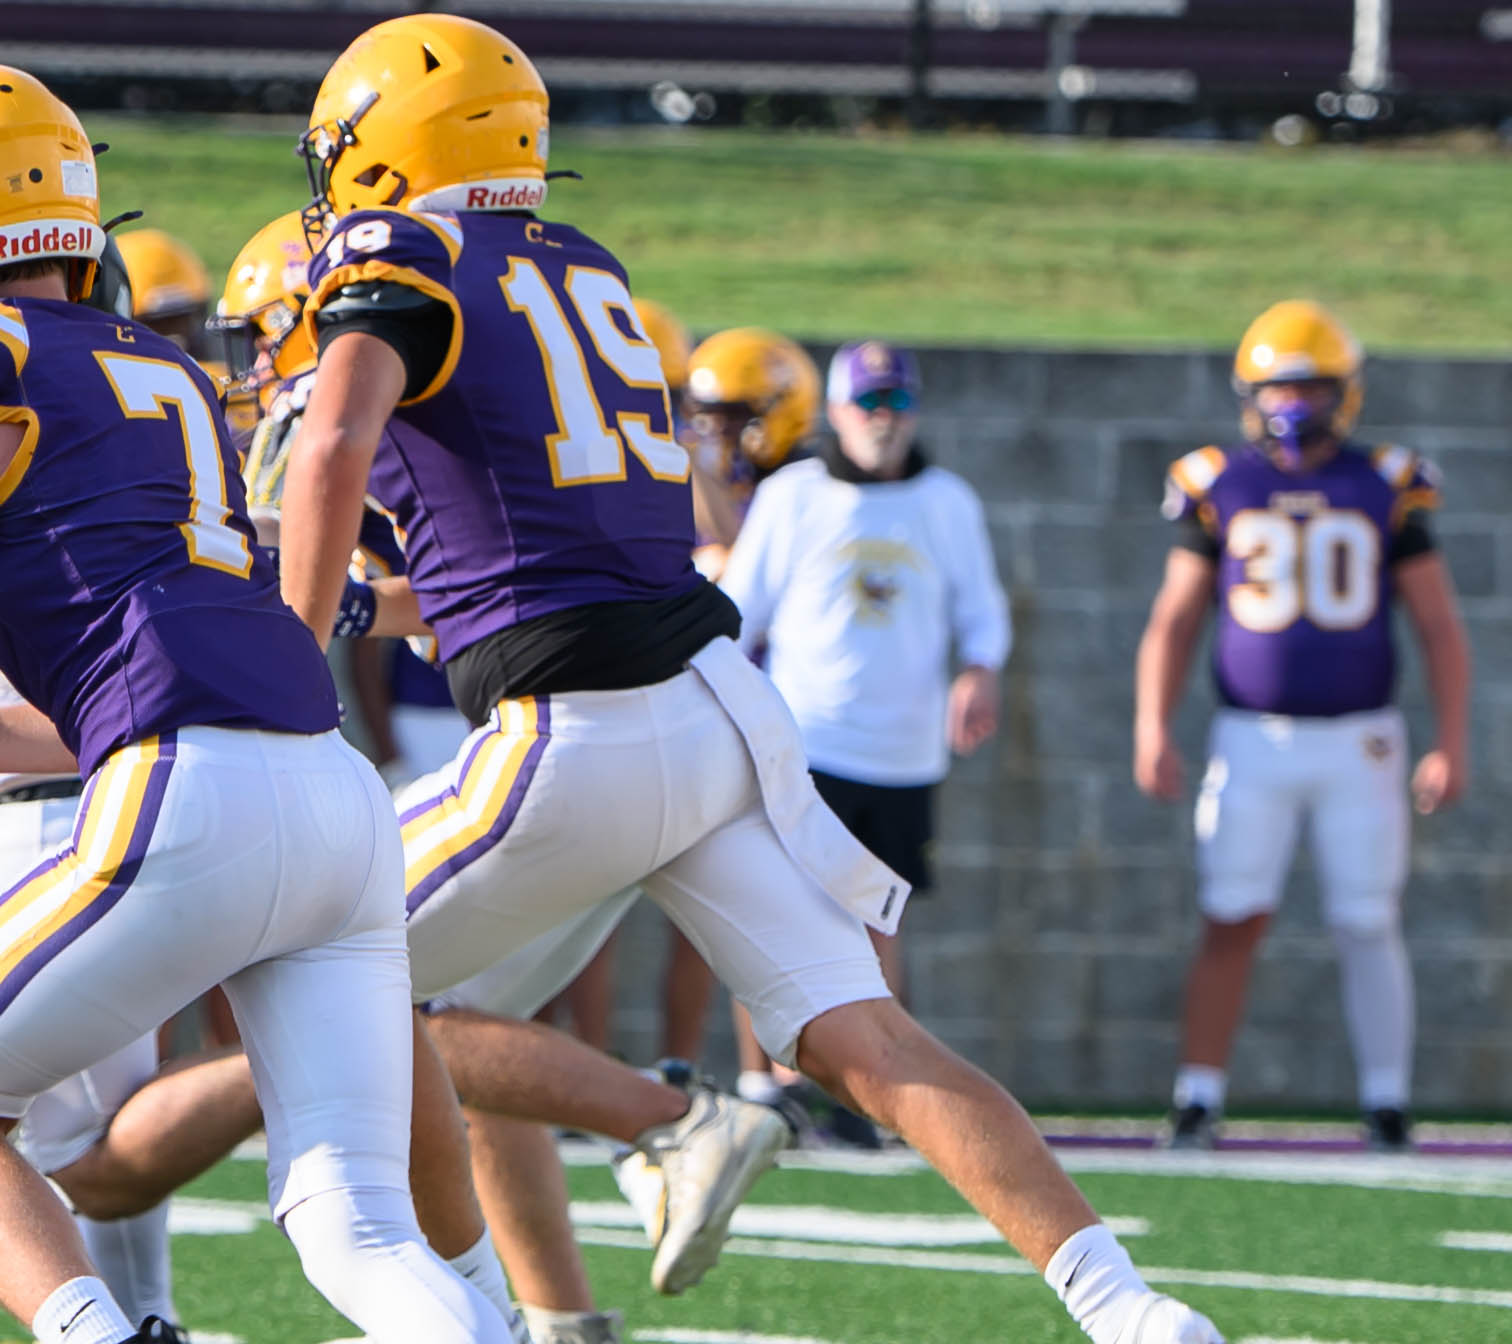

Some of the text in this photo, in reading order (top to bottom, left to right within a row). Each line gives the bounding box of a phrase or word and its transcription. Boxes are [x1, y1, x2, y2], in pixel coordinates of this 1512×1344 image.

[326, 219, 392, 269] 19
[466, 186, 544, 208] Riddel
[498, 256, 691, 489] 19
[91, 350, 254, 581] 7
[1228, 509, 1382, 633] 30
